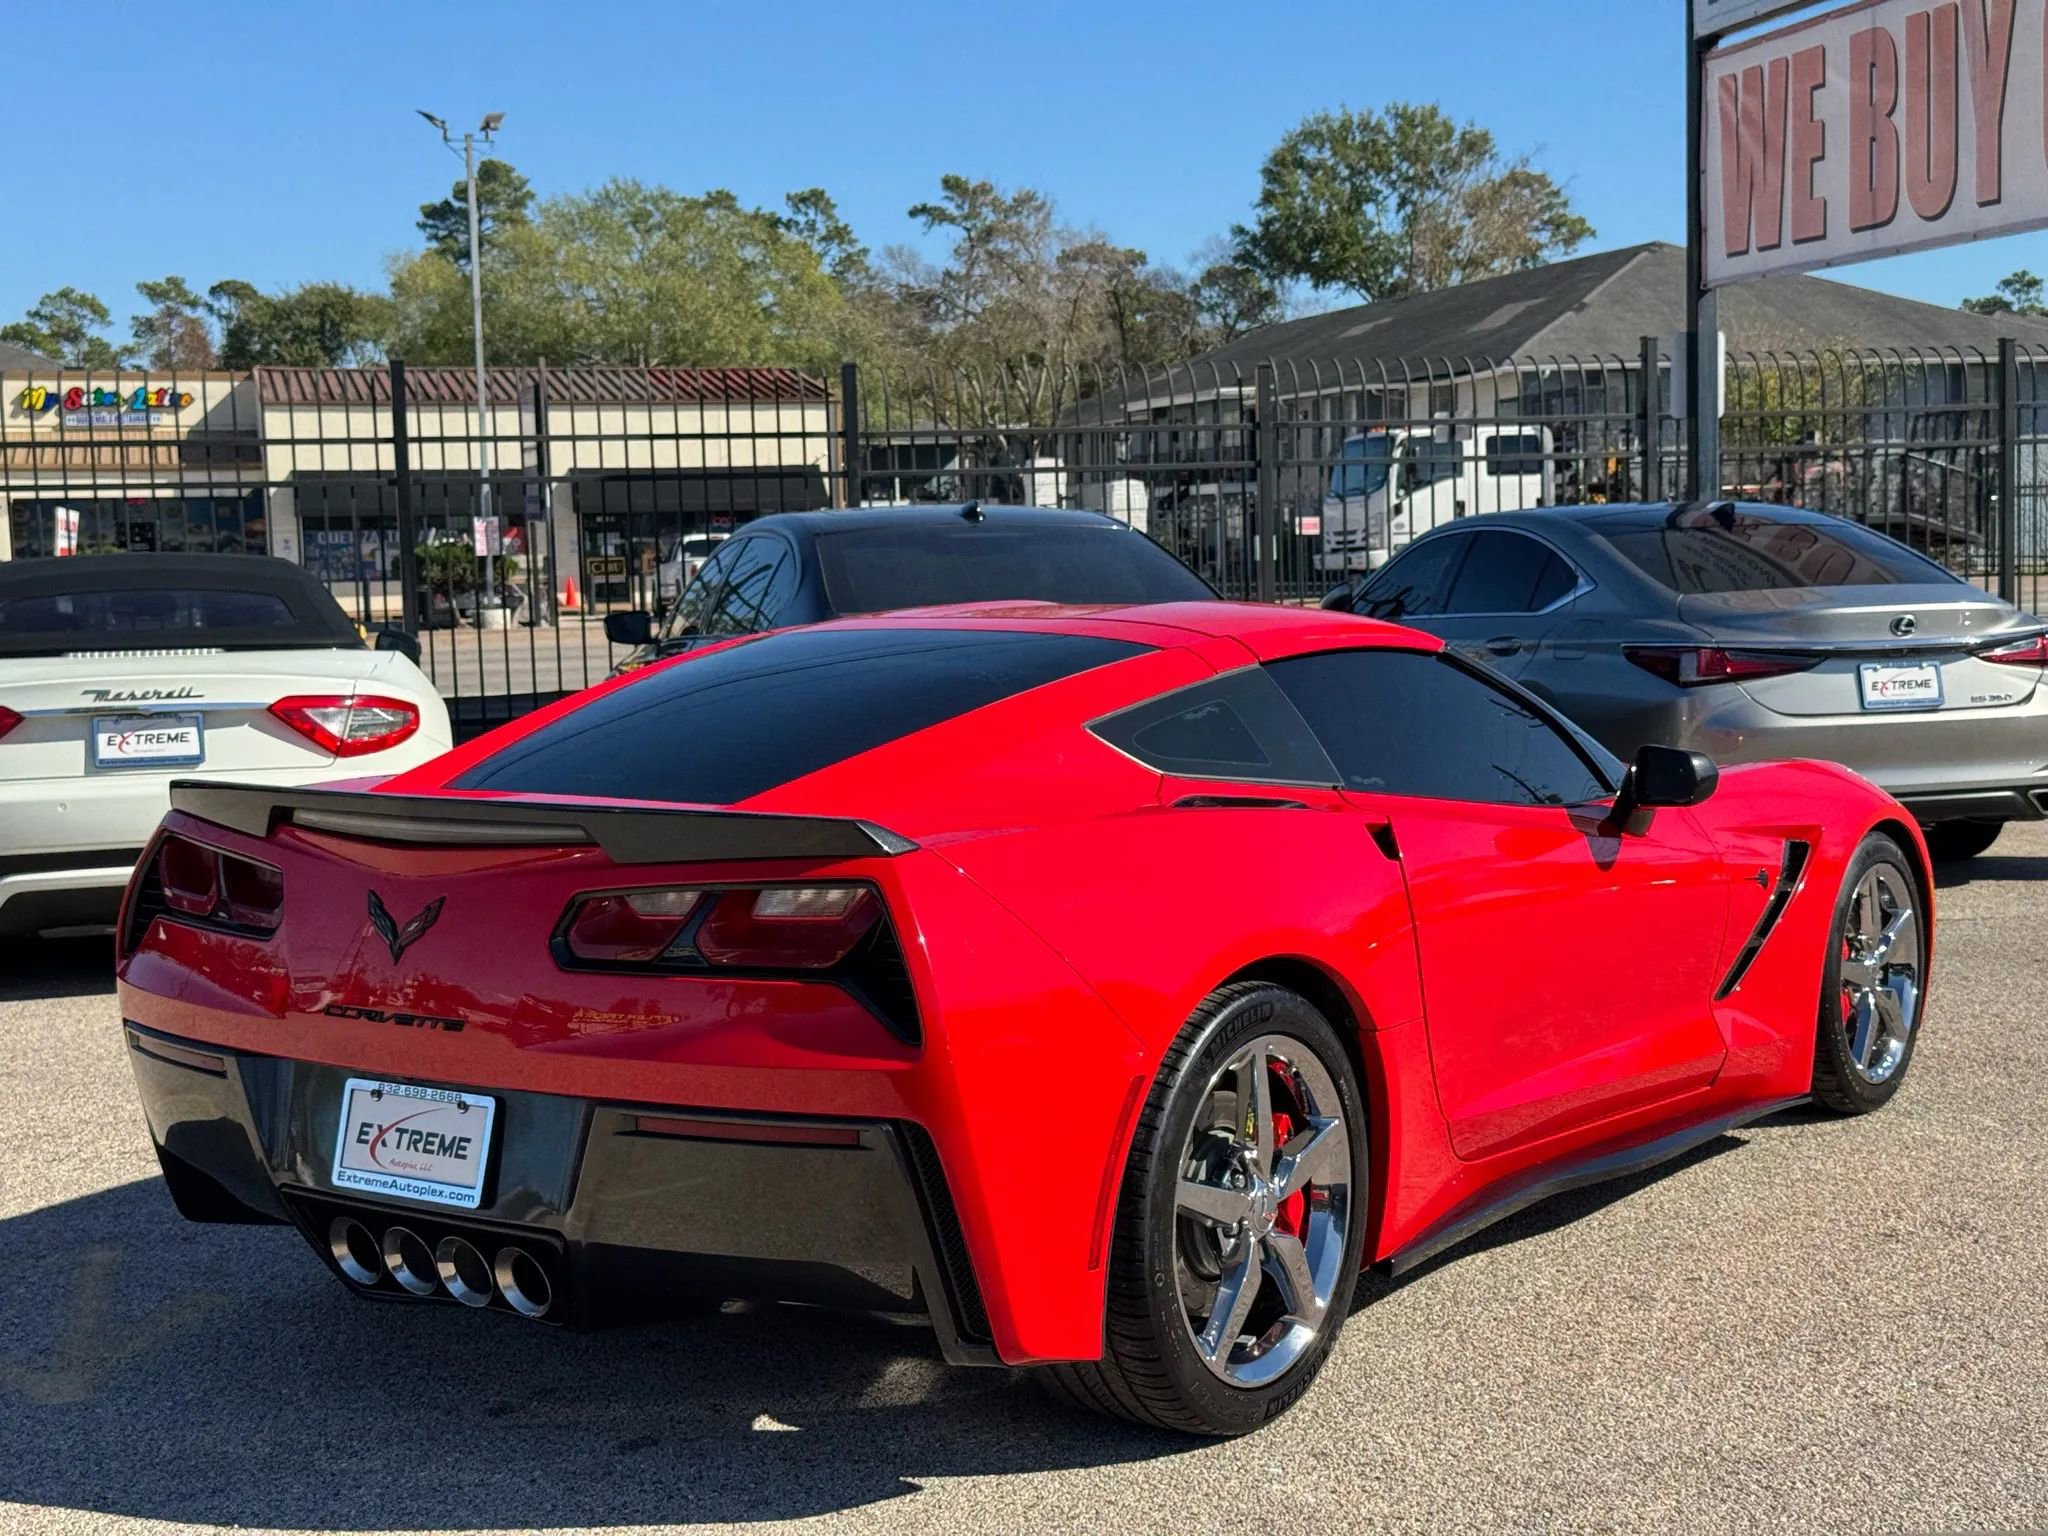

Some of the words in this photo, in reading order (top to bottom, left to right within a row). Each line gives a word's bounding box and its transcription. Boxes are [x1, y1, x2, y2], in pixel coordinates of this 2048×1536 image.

[1718, 44, 1826, 258] WE
[1850, 0, 2015, 233] BUY
[81, 686, 205, 702] Maserati
[1872, 679, 1932, 691] EXTREME
[107, 732, 191, 747] EXTREME
[324, 1003, 465, 1033] CORVETTE
[1210, 1003, 1272, 1057] MICHELIN
[356, 1121, 472, 1160] EXTREME
[337, 1170, 476, 1203] ExtremeAutoplex.com
